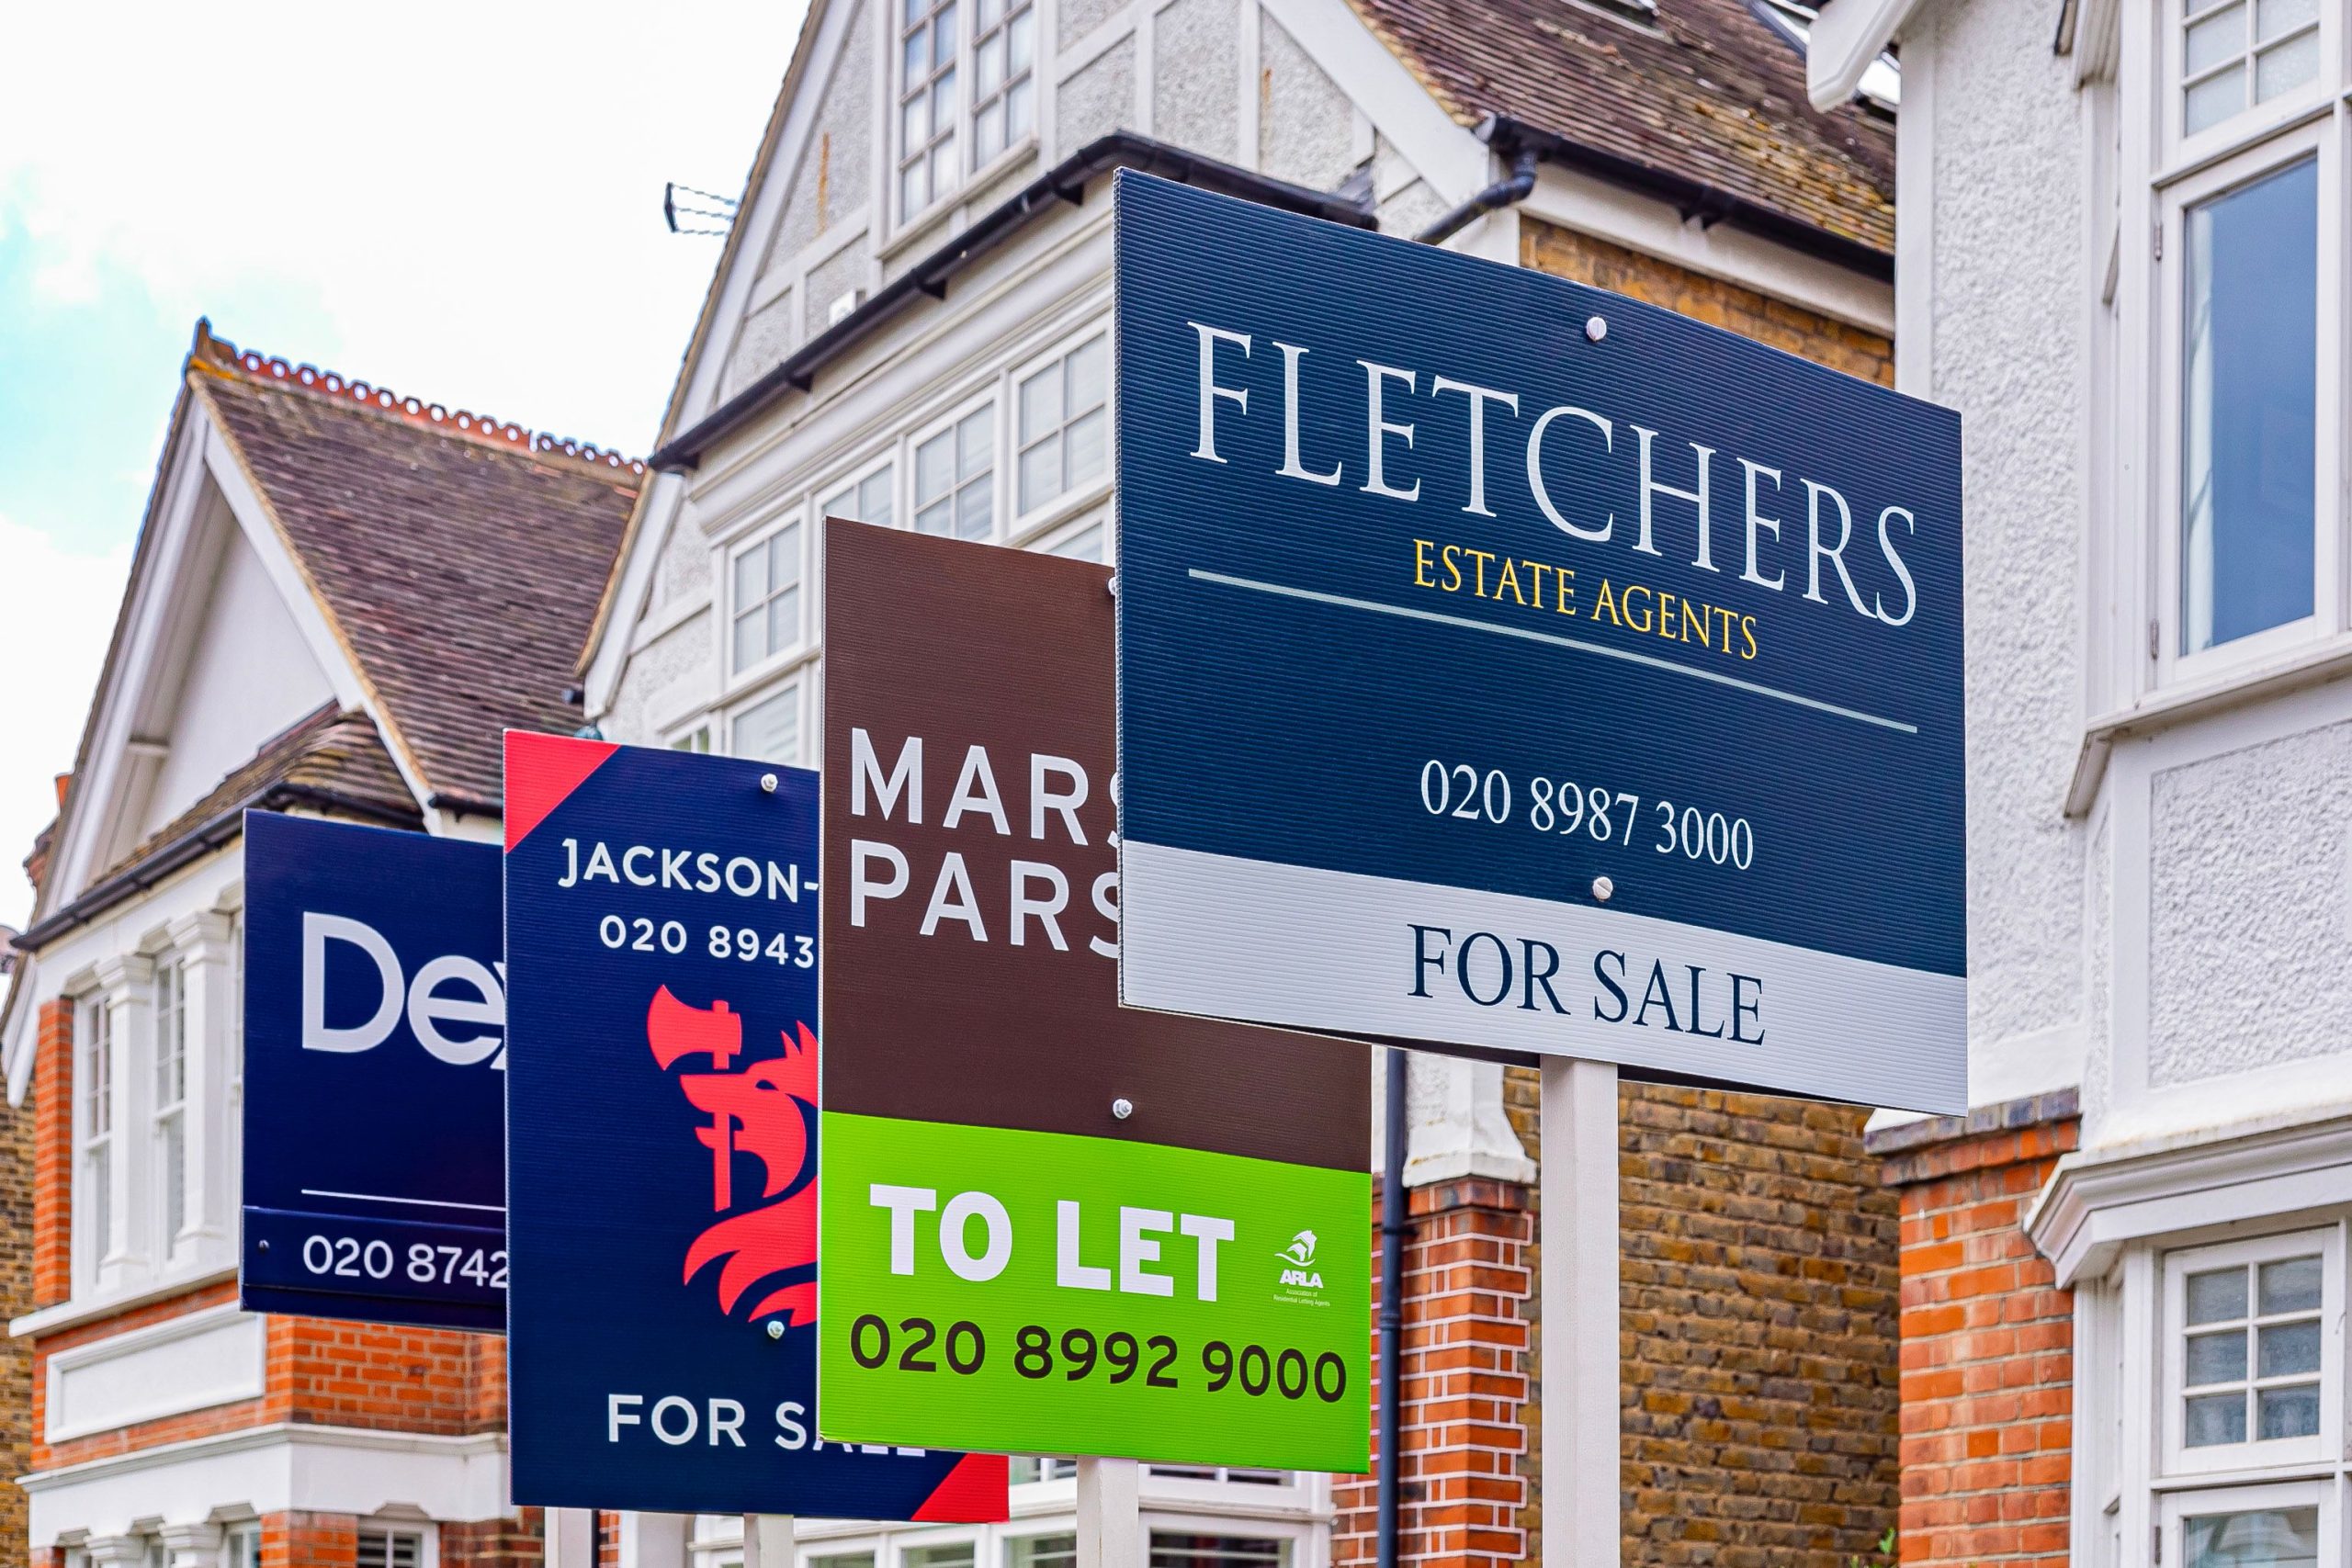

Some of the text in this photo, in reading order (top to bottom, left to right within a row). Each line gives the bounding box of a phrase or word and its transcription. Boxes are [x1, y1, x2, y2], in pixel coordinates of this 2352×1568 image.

[1187, 321, 1917, 627] FLETCHERS
[1414, 539, 1758, 661] ESTATE AGENTS
[852, 727, 1118, 849] MAR
[1420, 760, 1753, 870] 020 8987 3000
[302, 911, 506, 1071] De
[600, 915, 815, 968] 020 8943
[1408, 923, 1766, 1045] FOR SALE
[303, 1235, 509, 1288] 020 8742
[870, 1183, 1235, 1303] TO LET
[1279, 1269, 1323, 1289] ARLA
[851, 1314, 1347, 1403] 020 8992 9000
[608, 1393, 746, 1448] FOR
